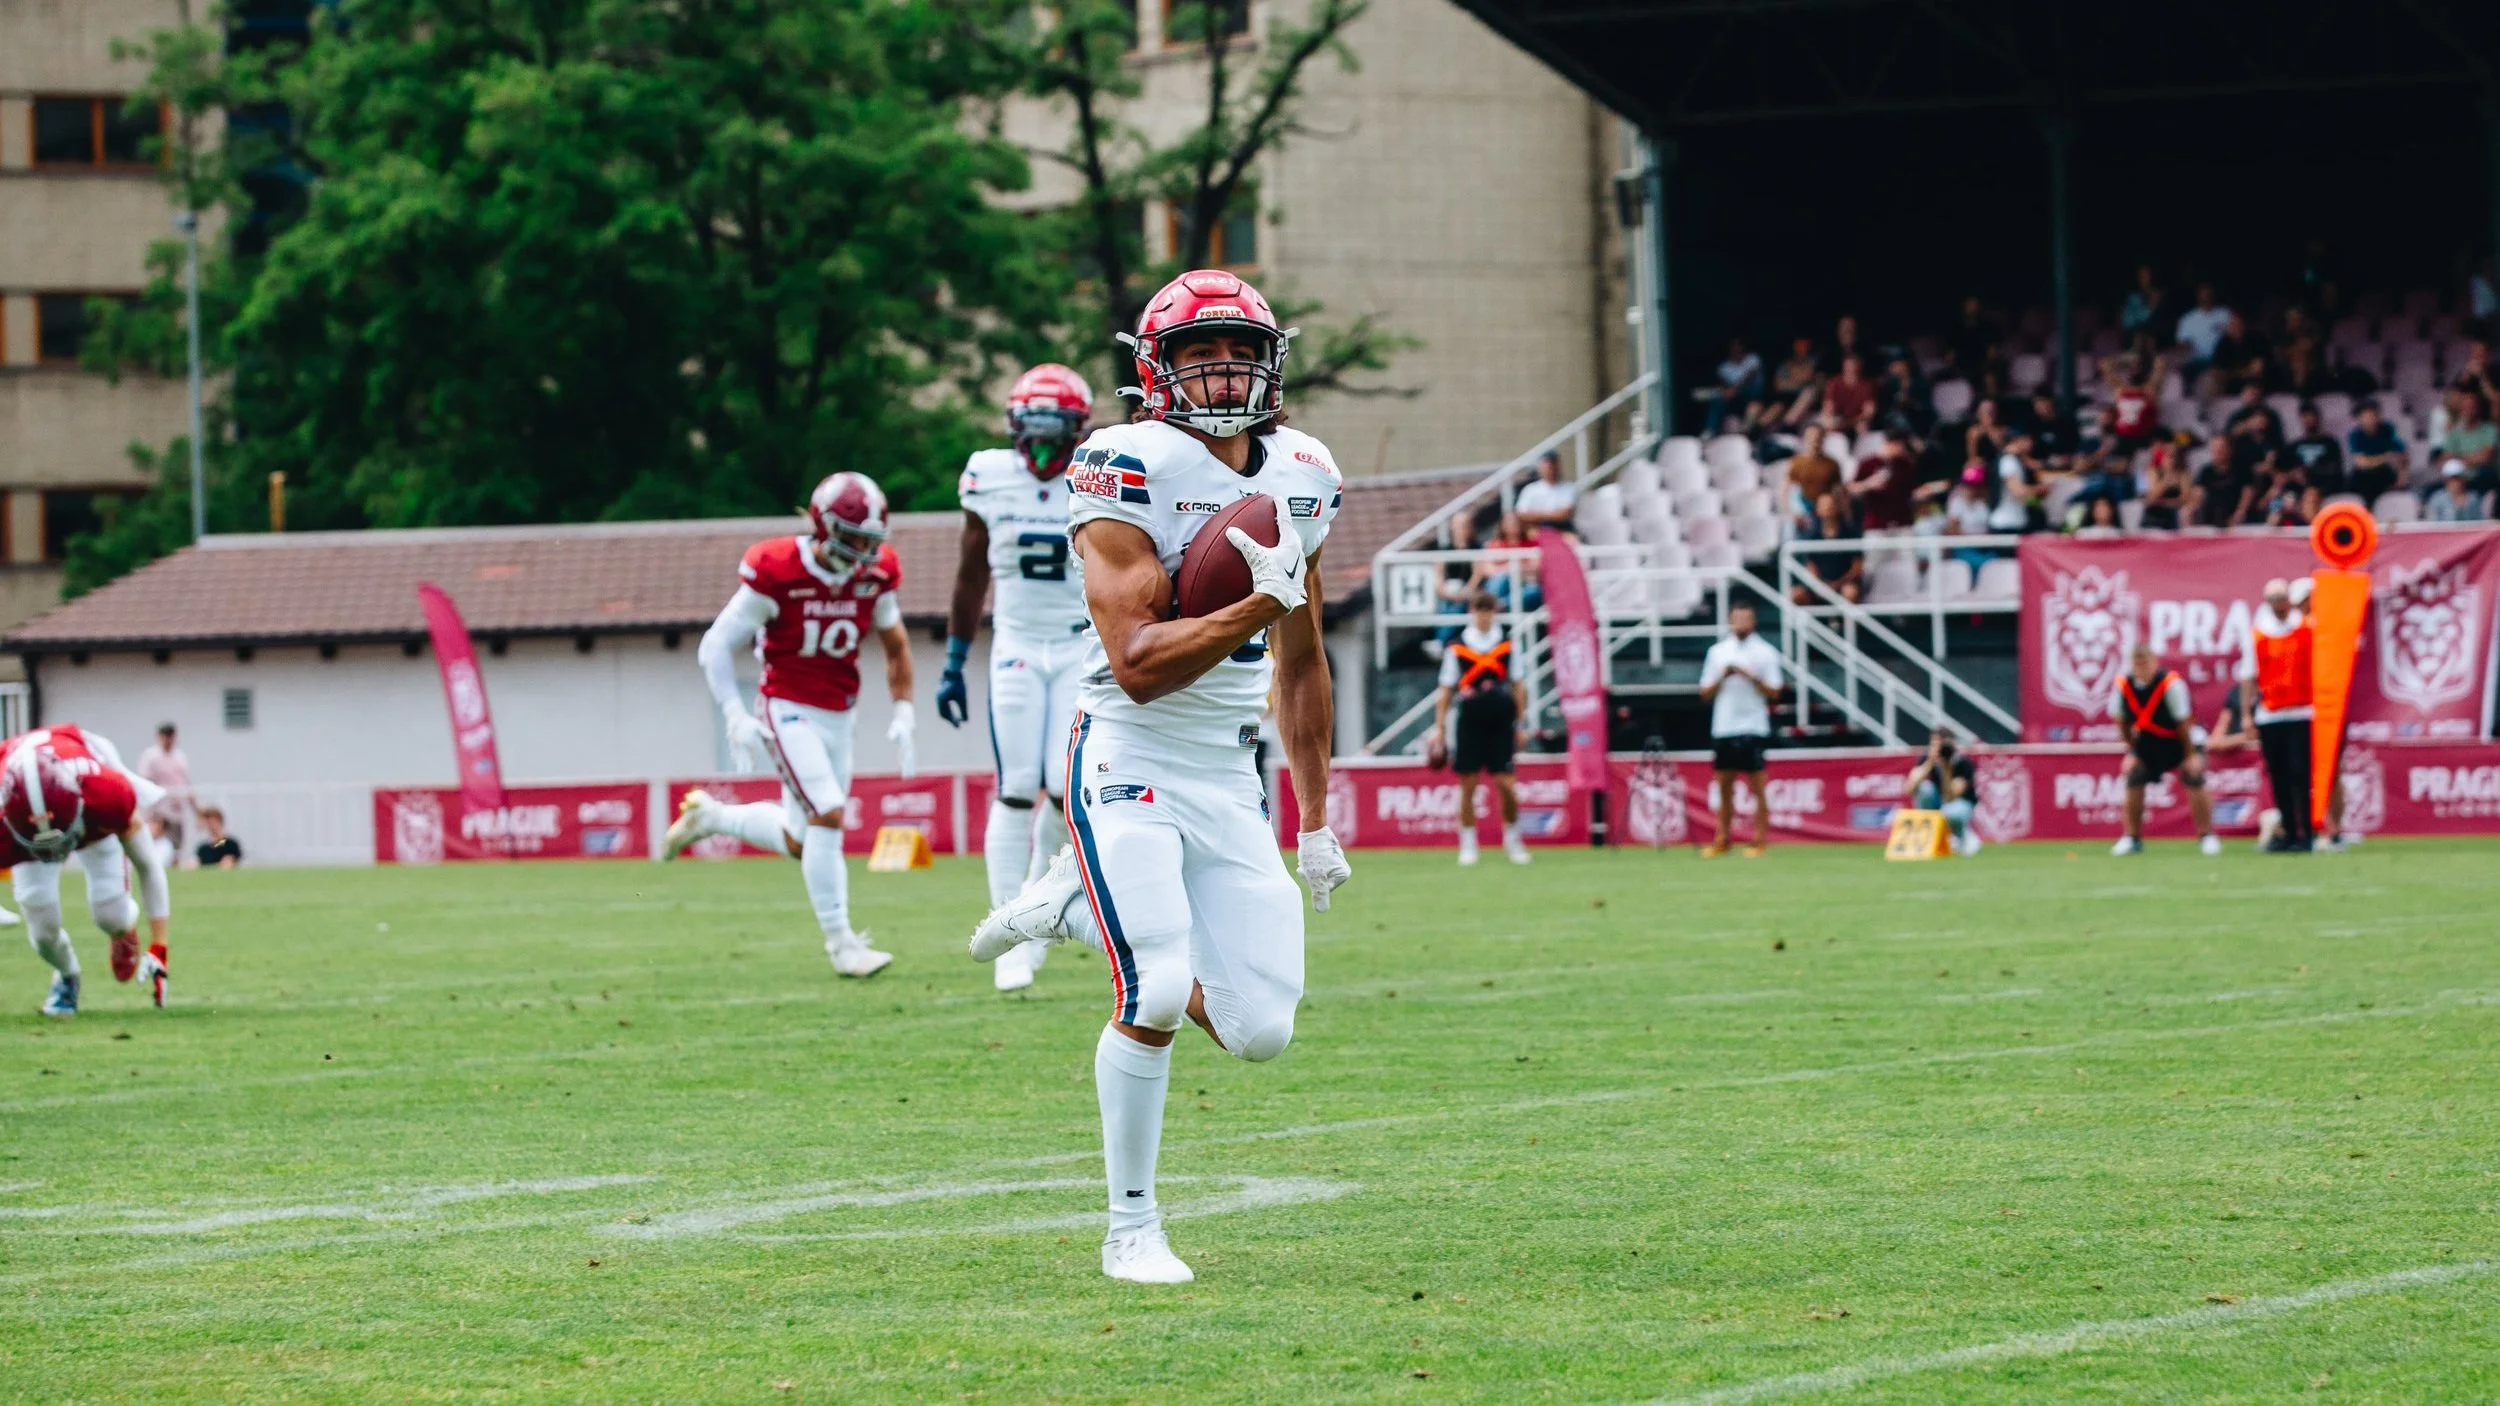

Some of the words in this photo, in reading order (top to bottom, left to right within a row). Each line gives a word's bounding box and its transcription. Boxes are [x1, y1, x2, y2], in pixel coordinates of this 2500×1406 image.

[1199, 309, 1241, 318] FORELLE
[1018, 533, 1069, 581] 2
[1401, 574, 1425, 606] H
[803, 600, 857, 618] PRAGUE
[798, 618, 860, 659] 10
[2151, 599, 2252, 657] PRA
